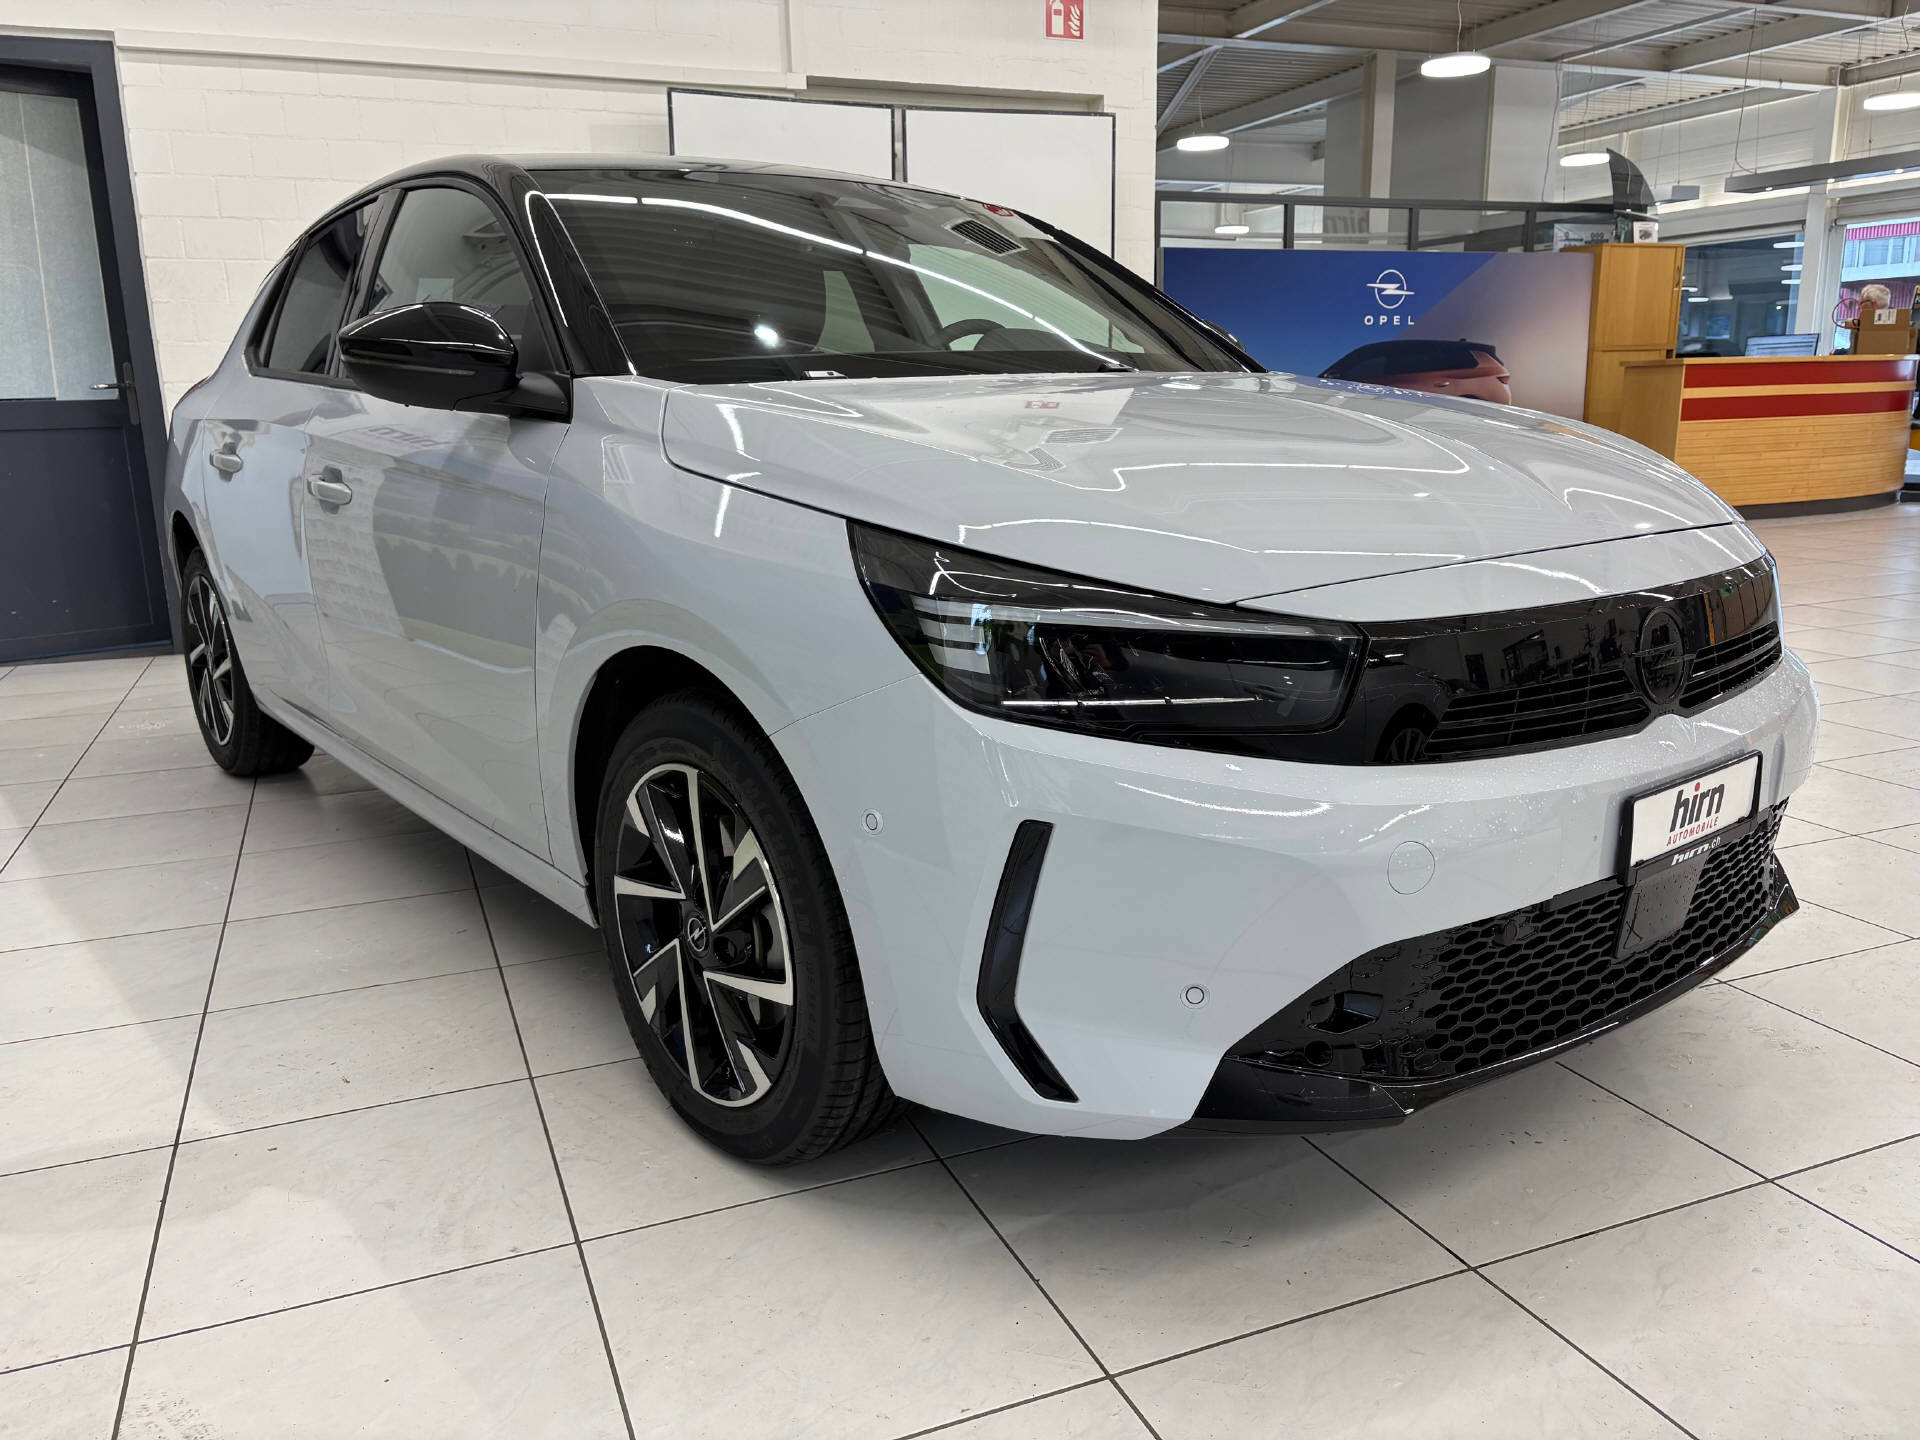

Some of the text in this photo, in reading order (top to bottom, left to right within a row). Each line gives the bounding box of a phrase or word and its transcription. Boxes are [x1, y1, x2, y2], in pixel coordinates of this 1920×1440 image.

[1364, 315, 1415, 325] OPEL
[1669, 782, 1724, 833] hirn
[1667, 816, 1719, 846] AUTOMOBILE
[1671, 836, 1721, 866] hirn.ch
